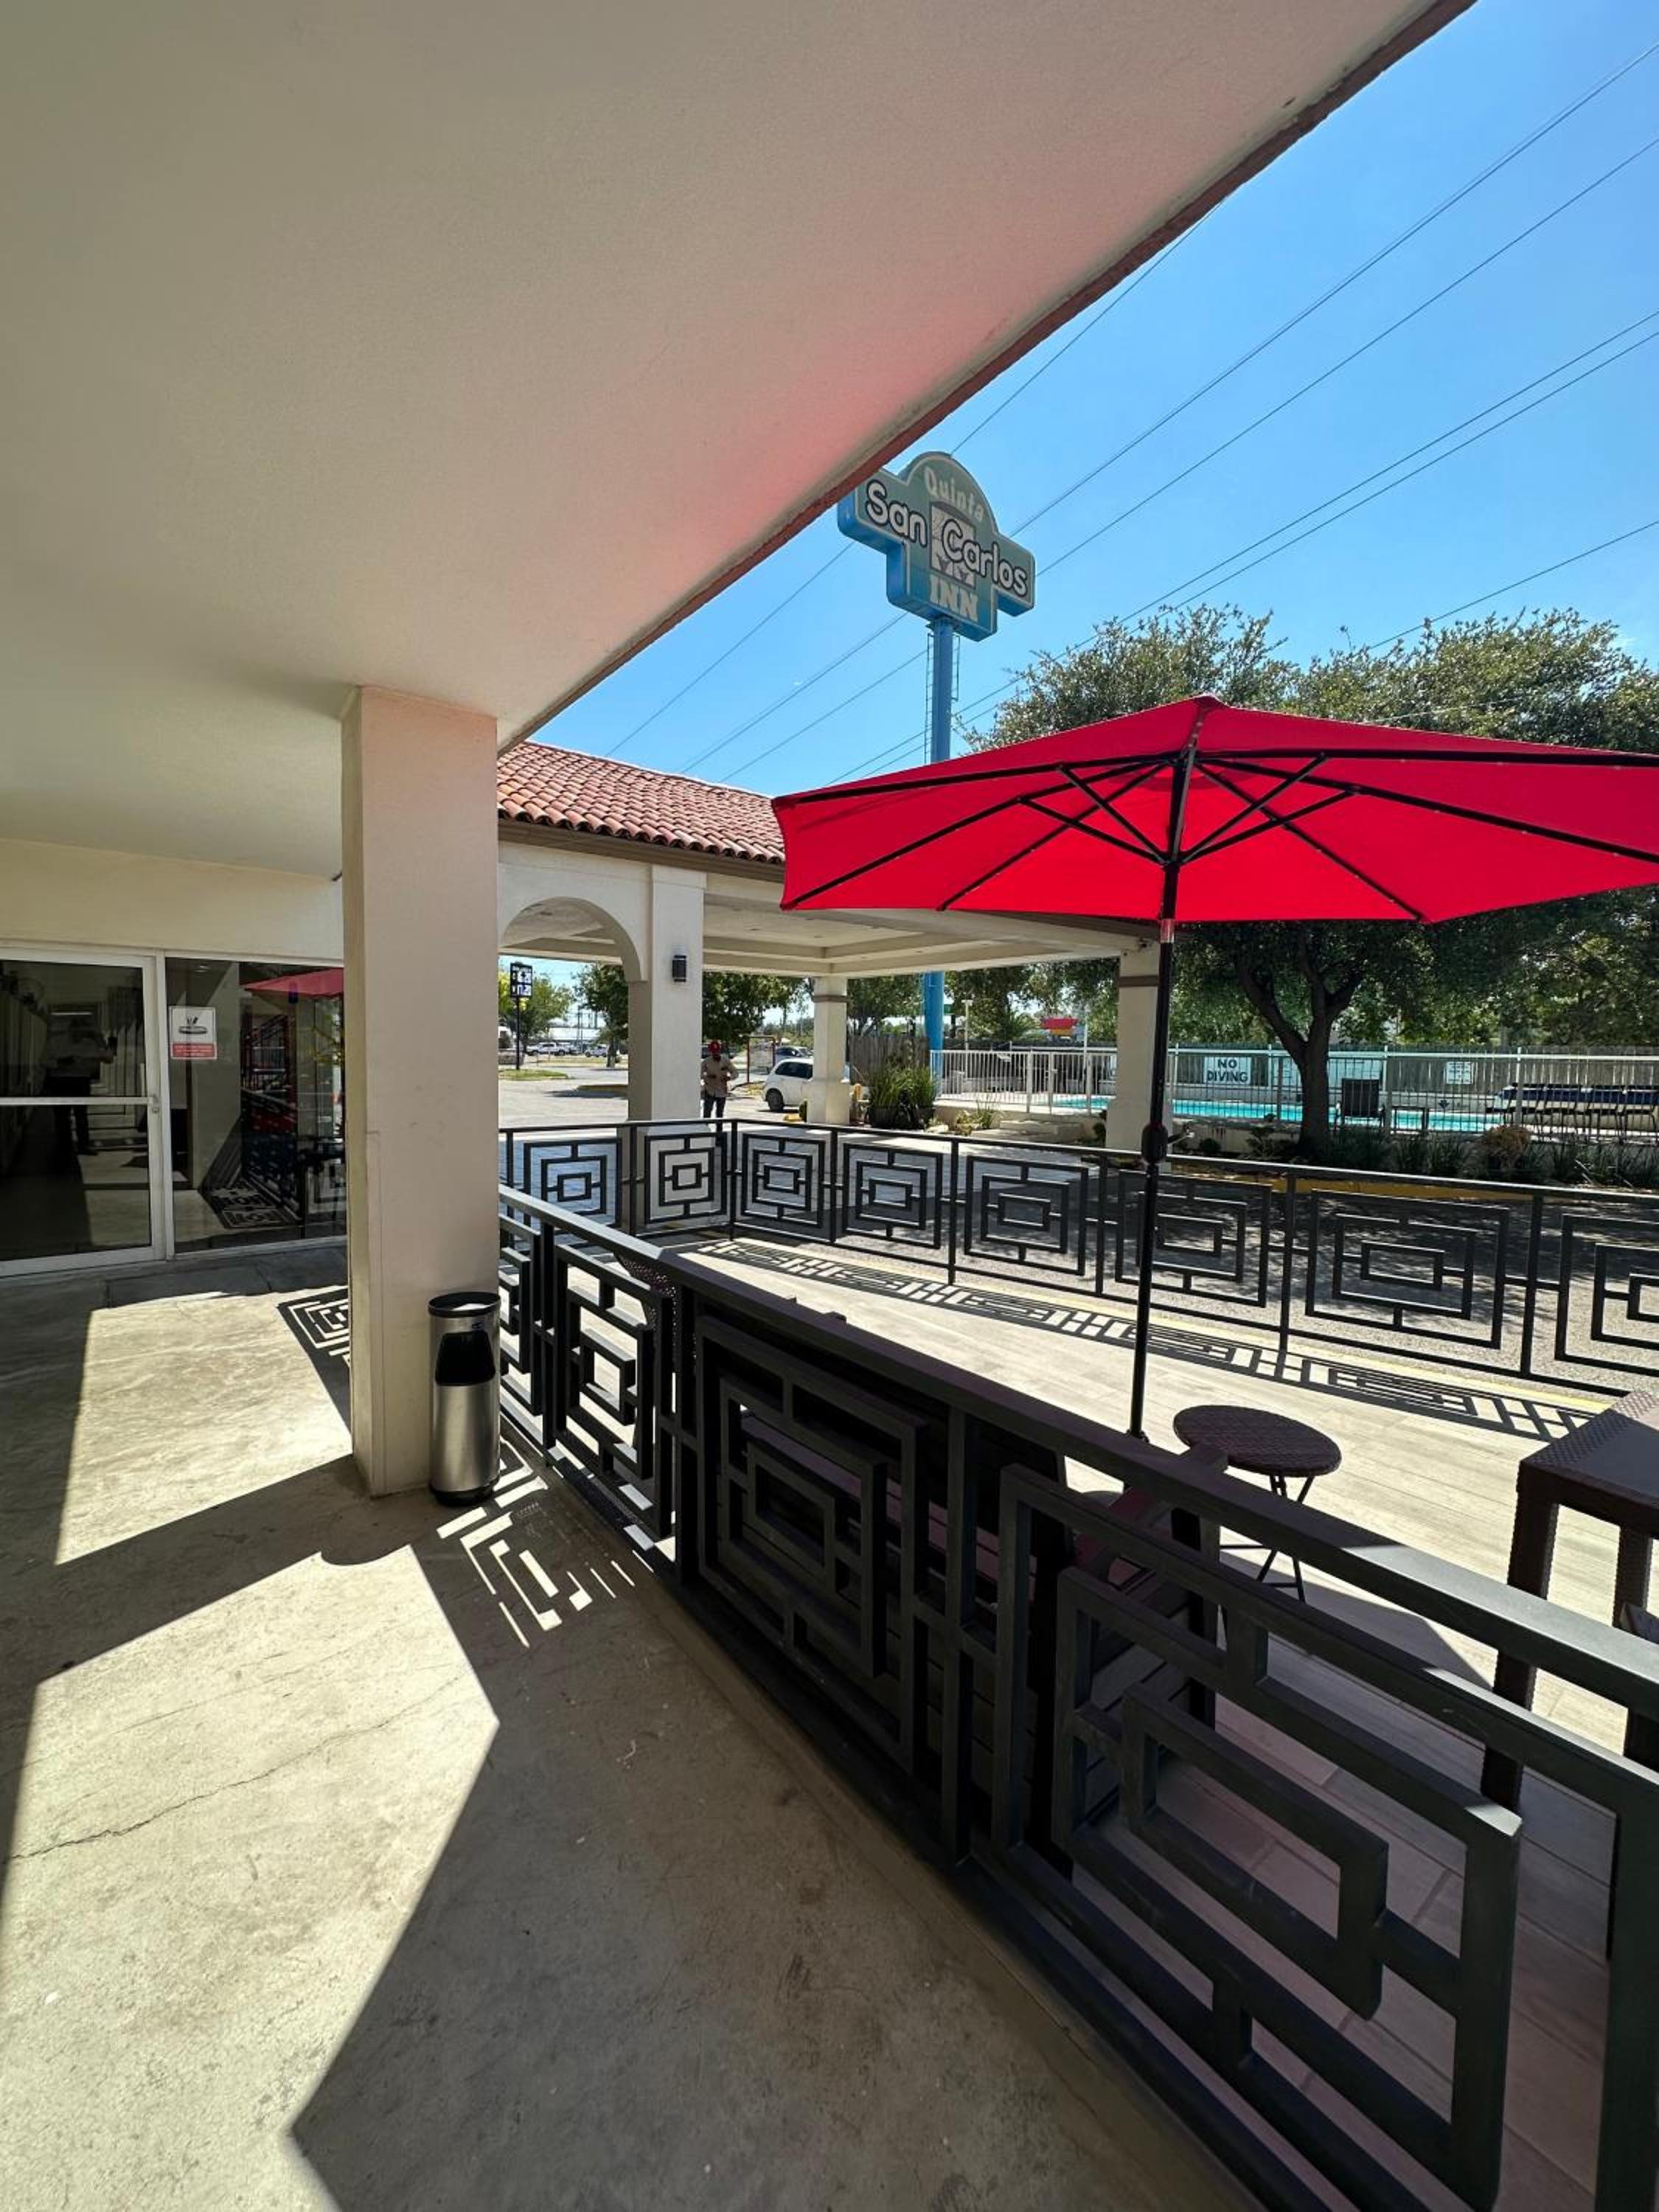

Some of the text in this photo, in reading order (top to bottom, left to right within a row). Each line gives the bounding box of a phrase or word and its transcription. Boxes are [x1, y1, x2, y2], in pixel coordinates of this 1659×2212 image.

[924, 466, 985, 522] Quinta
[866, 479, 1029, 597] San Carlos
[929, 574, 978, 622] INN
[1207, 1071, 1248, 1082] DIVING
[1218, 1058, 1238, 1068] NO
